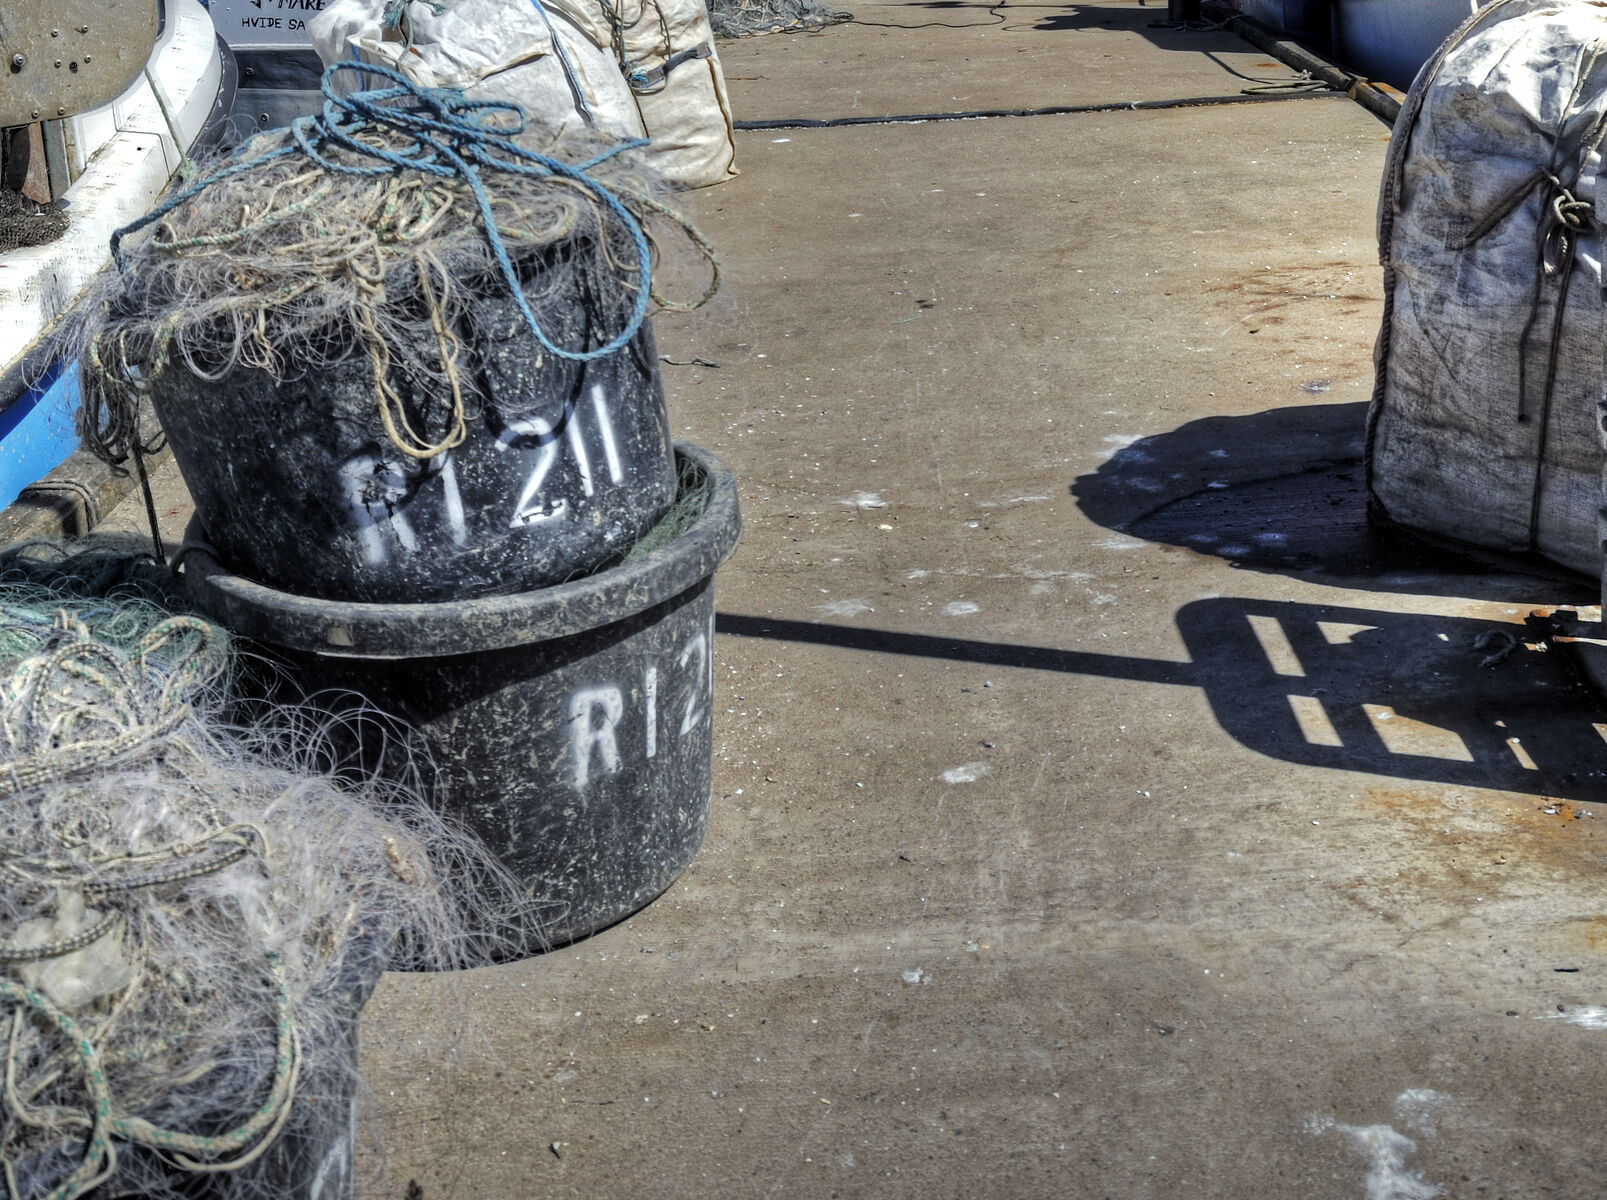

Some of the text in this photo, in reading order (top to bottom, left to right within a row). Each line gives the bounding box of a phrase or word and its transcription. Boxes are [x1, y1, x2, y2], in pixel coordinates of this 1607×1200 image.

[241, 17, 282, 29] HVIDE
[338, 449, 468, 566] RI
[569, 666, 657, 788] RI
